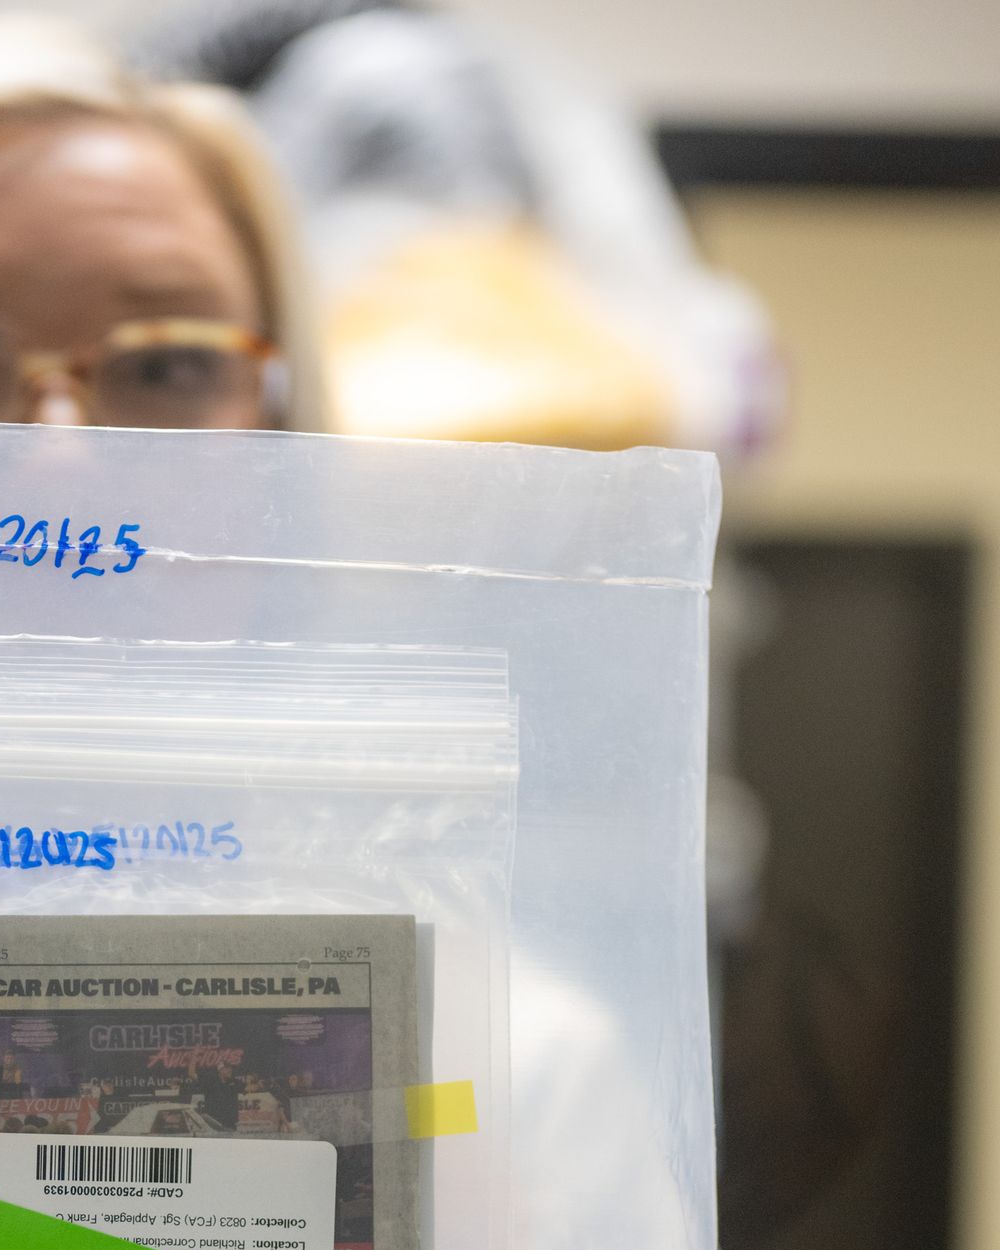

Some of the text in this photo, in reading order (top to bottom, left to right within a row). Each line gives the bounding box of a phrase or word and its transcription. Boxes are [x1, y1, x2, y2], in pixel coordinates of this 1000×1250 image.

[324, 947, 370, 961] Page 75
[46, 977, 159, 997] AUCTION
[175, 977, 302, 999] CARLISLE,
[307, 977, 340, 996] PA
[89, 1023, 222, 1050] CARLISLE
[147, 1187, 184, 1198] CAD#:
[67, 1212, 306, 1229] Collector: 0823 (FCA) Sgt. Applegate, Frank
[199, 1239, 246, 1250] Richland
[252, 1239, 306, 1250] Location:
